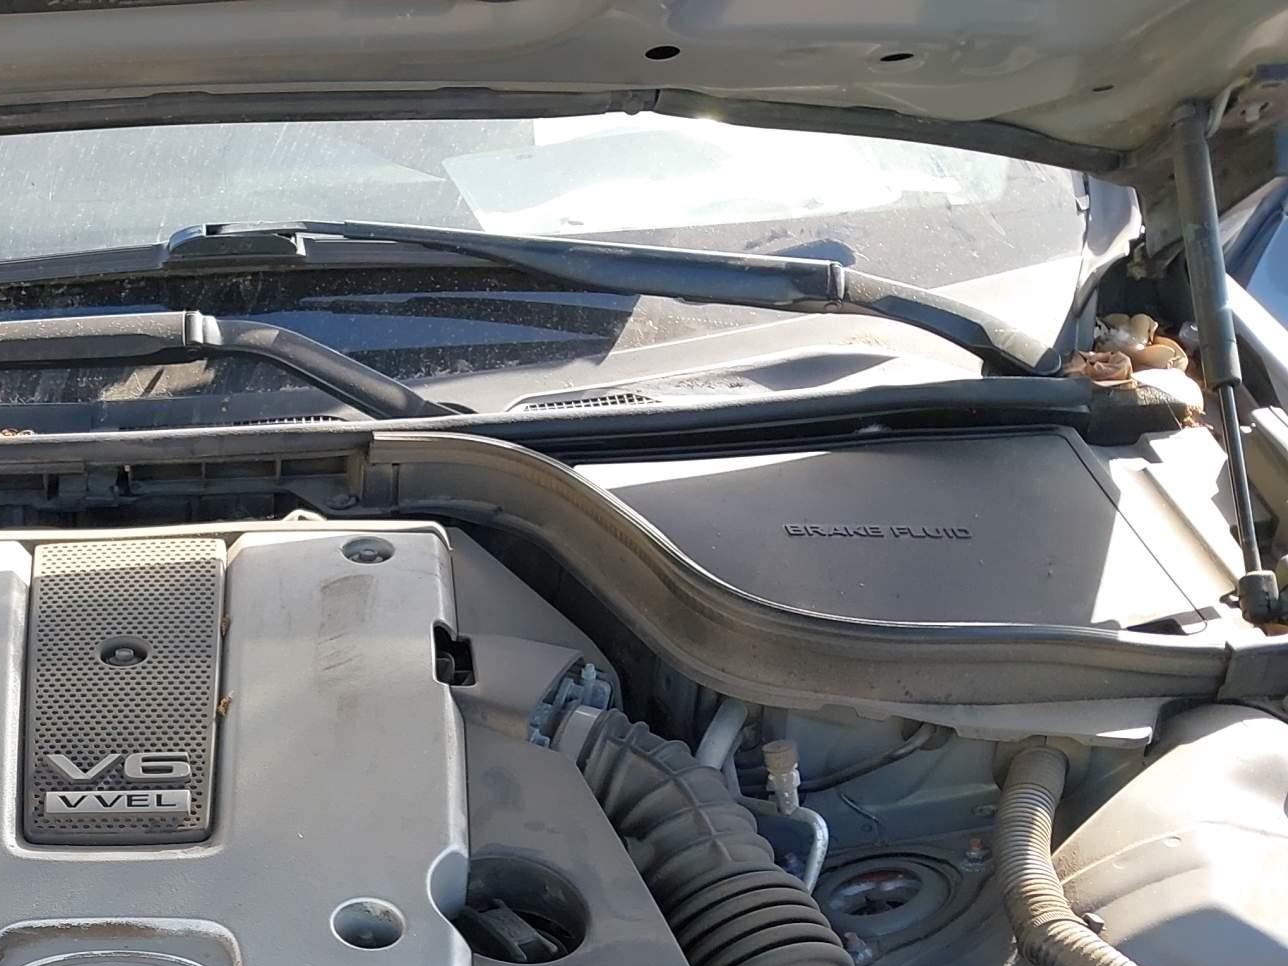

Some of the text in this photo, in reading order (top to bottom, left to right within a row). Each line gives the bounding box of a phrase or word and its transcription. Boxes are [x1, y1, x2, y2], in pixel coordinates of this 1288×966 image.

[783, 524, 972, 540] BRAKE FLUID
[46, 751, 192, 785] V6
[58, 793, 177, 808] VVEL
